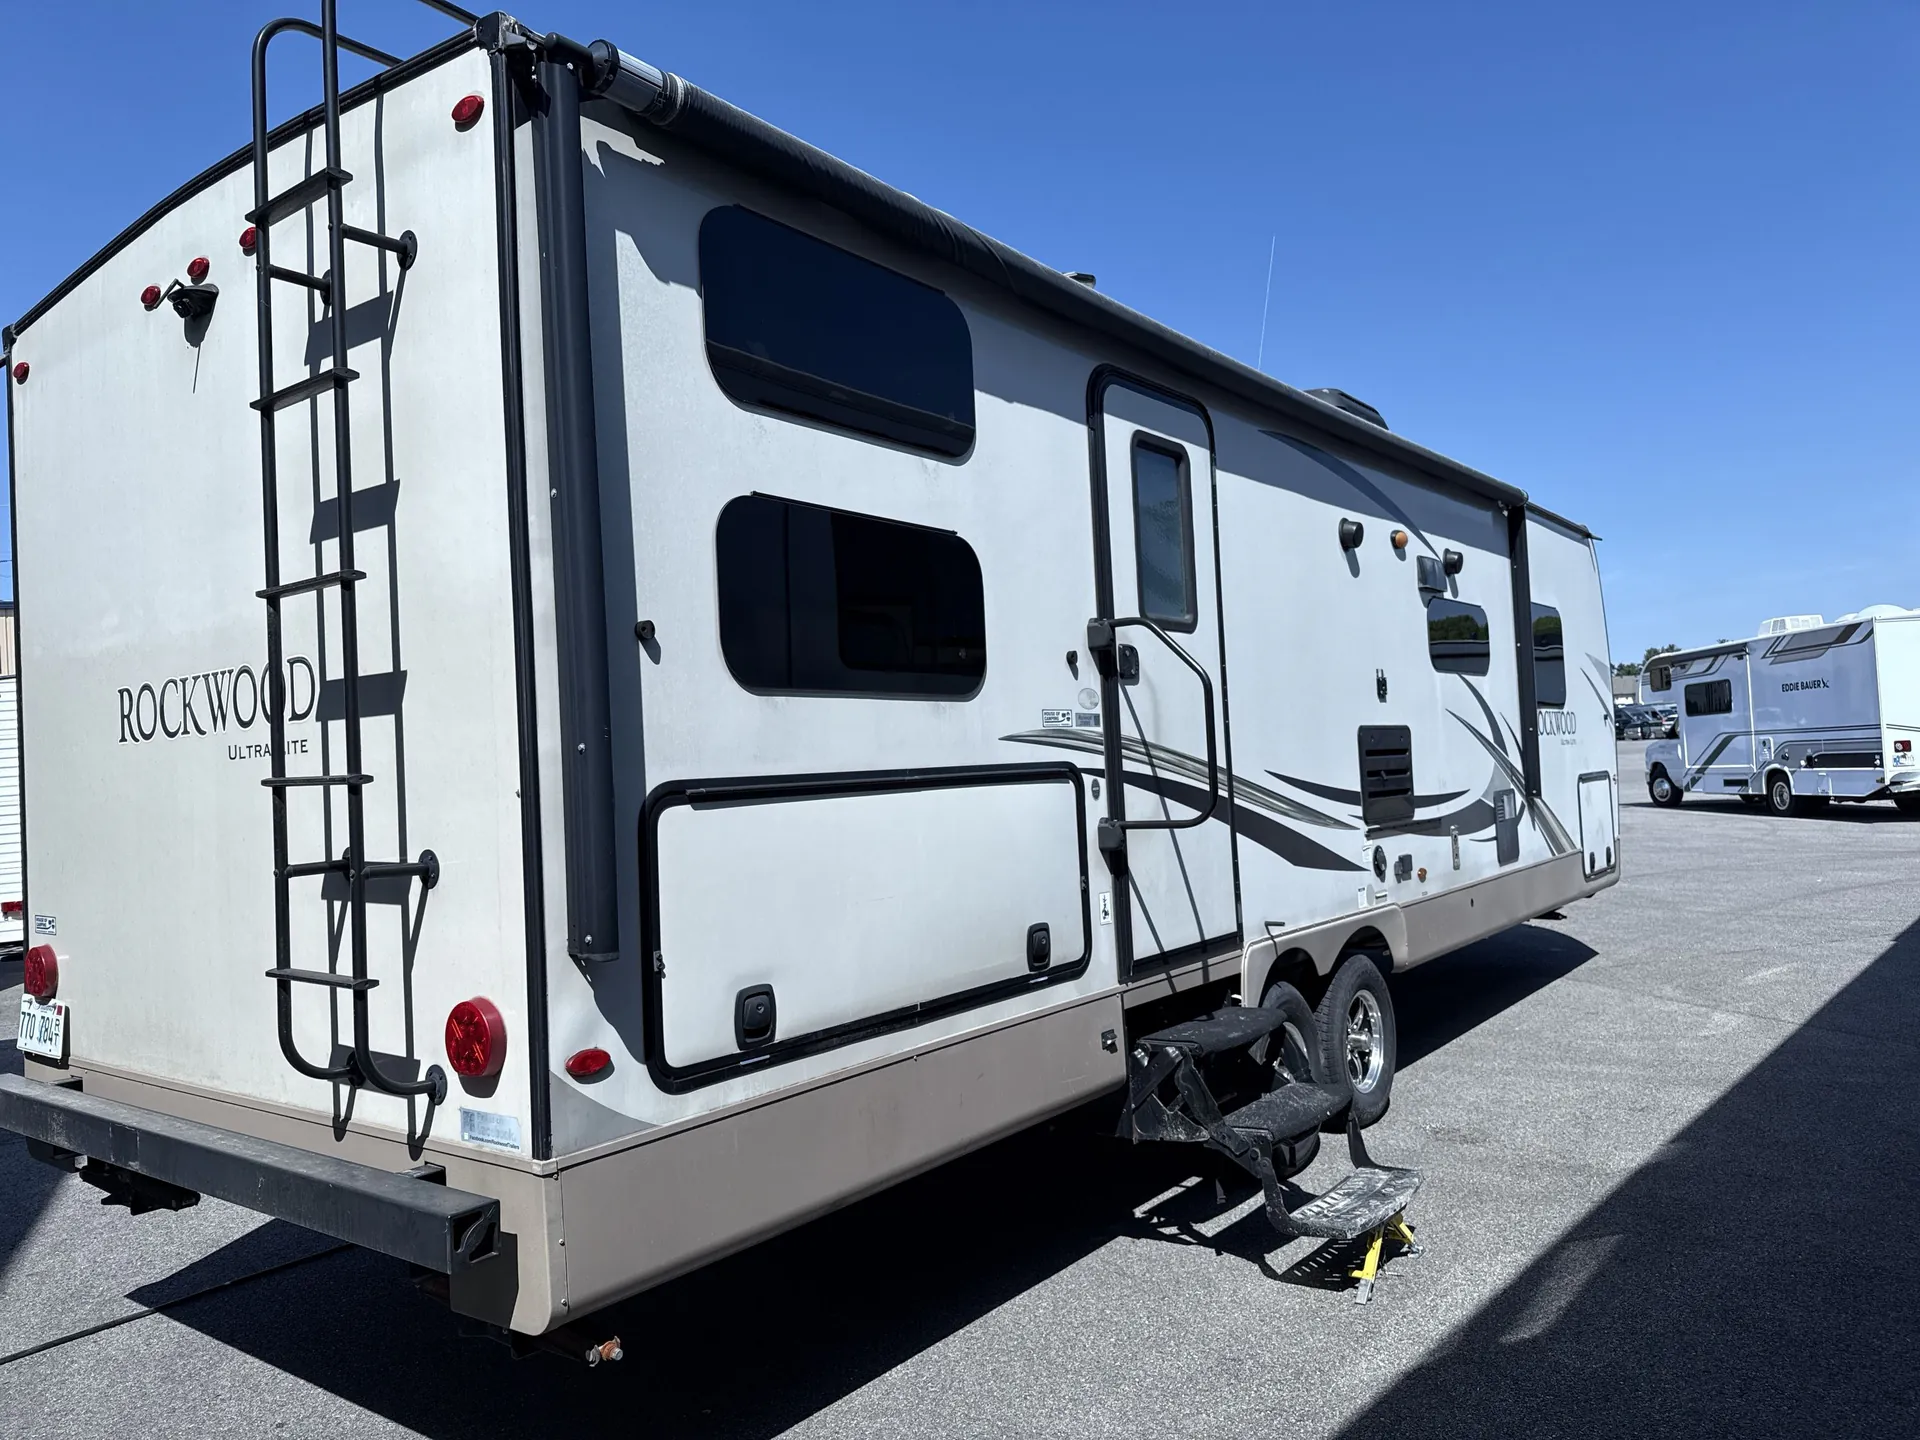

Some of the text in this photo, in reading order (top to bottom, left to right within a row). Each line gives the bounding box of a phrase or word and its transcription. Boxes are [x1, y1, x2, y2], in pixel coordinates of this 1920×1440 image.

[1781, 679, 1821, 692] EDDIE BAUER
[1537, 710, 1577, 736] OCKWOOD
[228, 739, 309, 760] ULTRA ITE
[20, 1011, 37, 1040] 770
